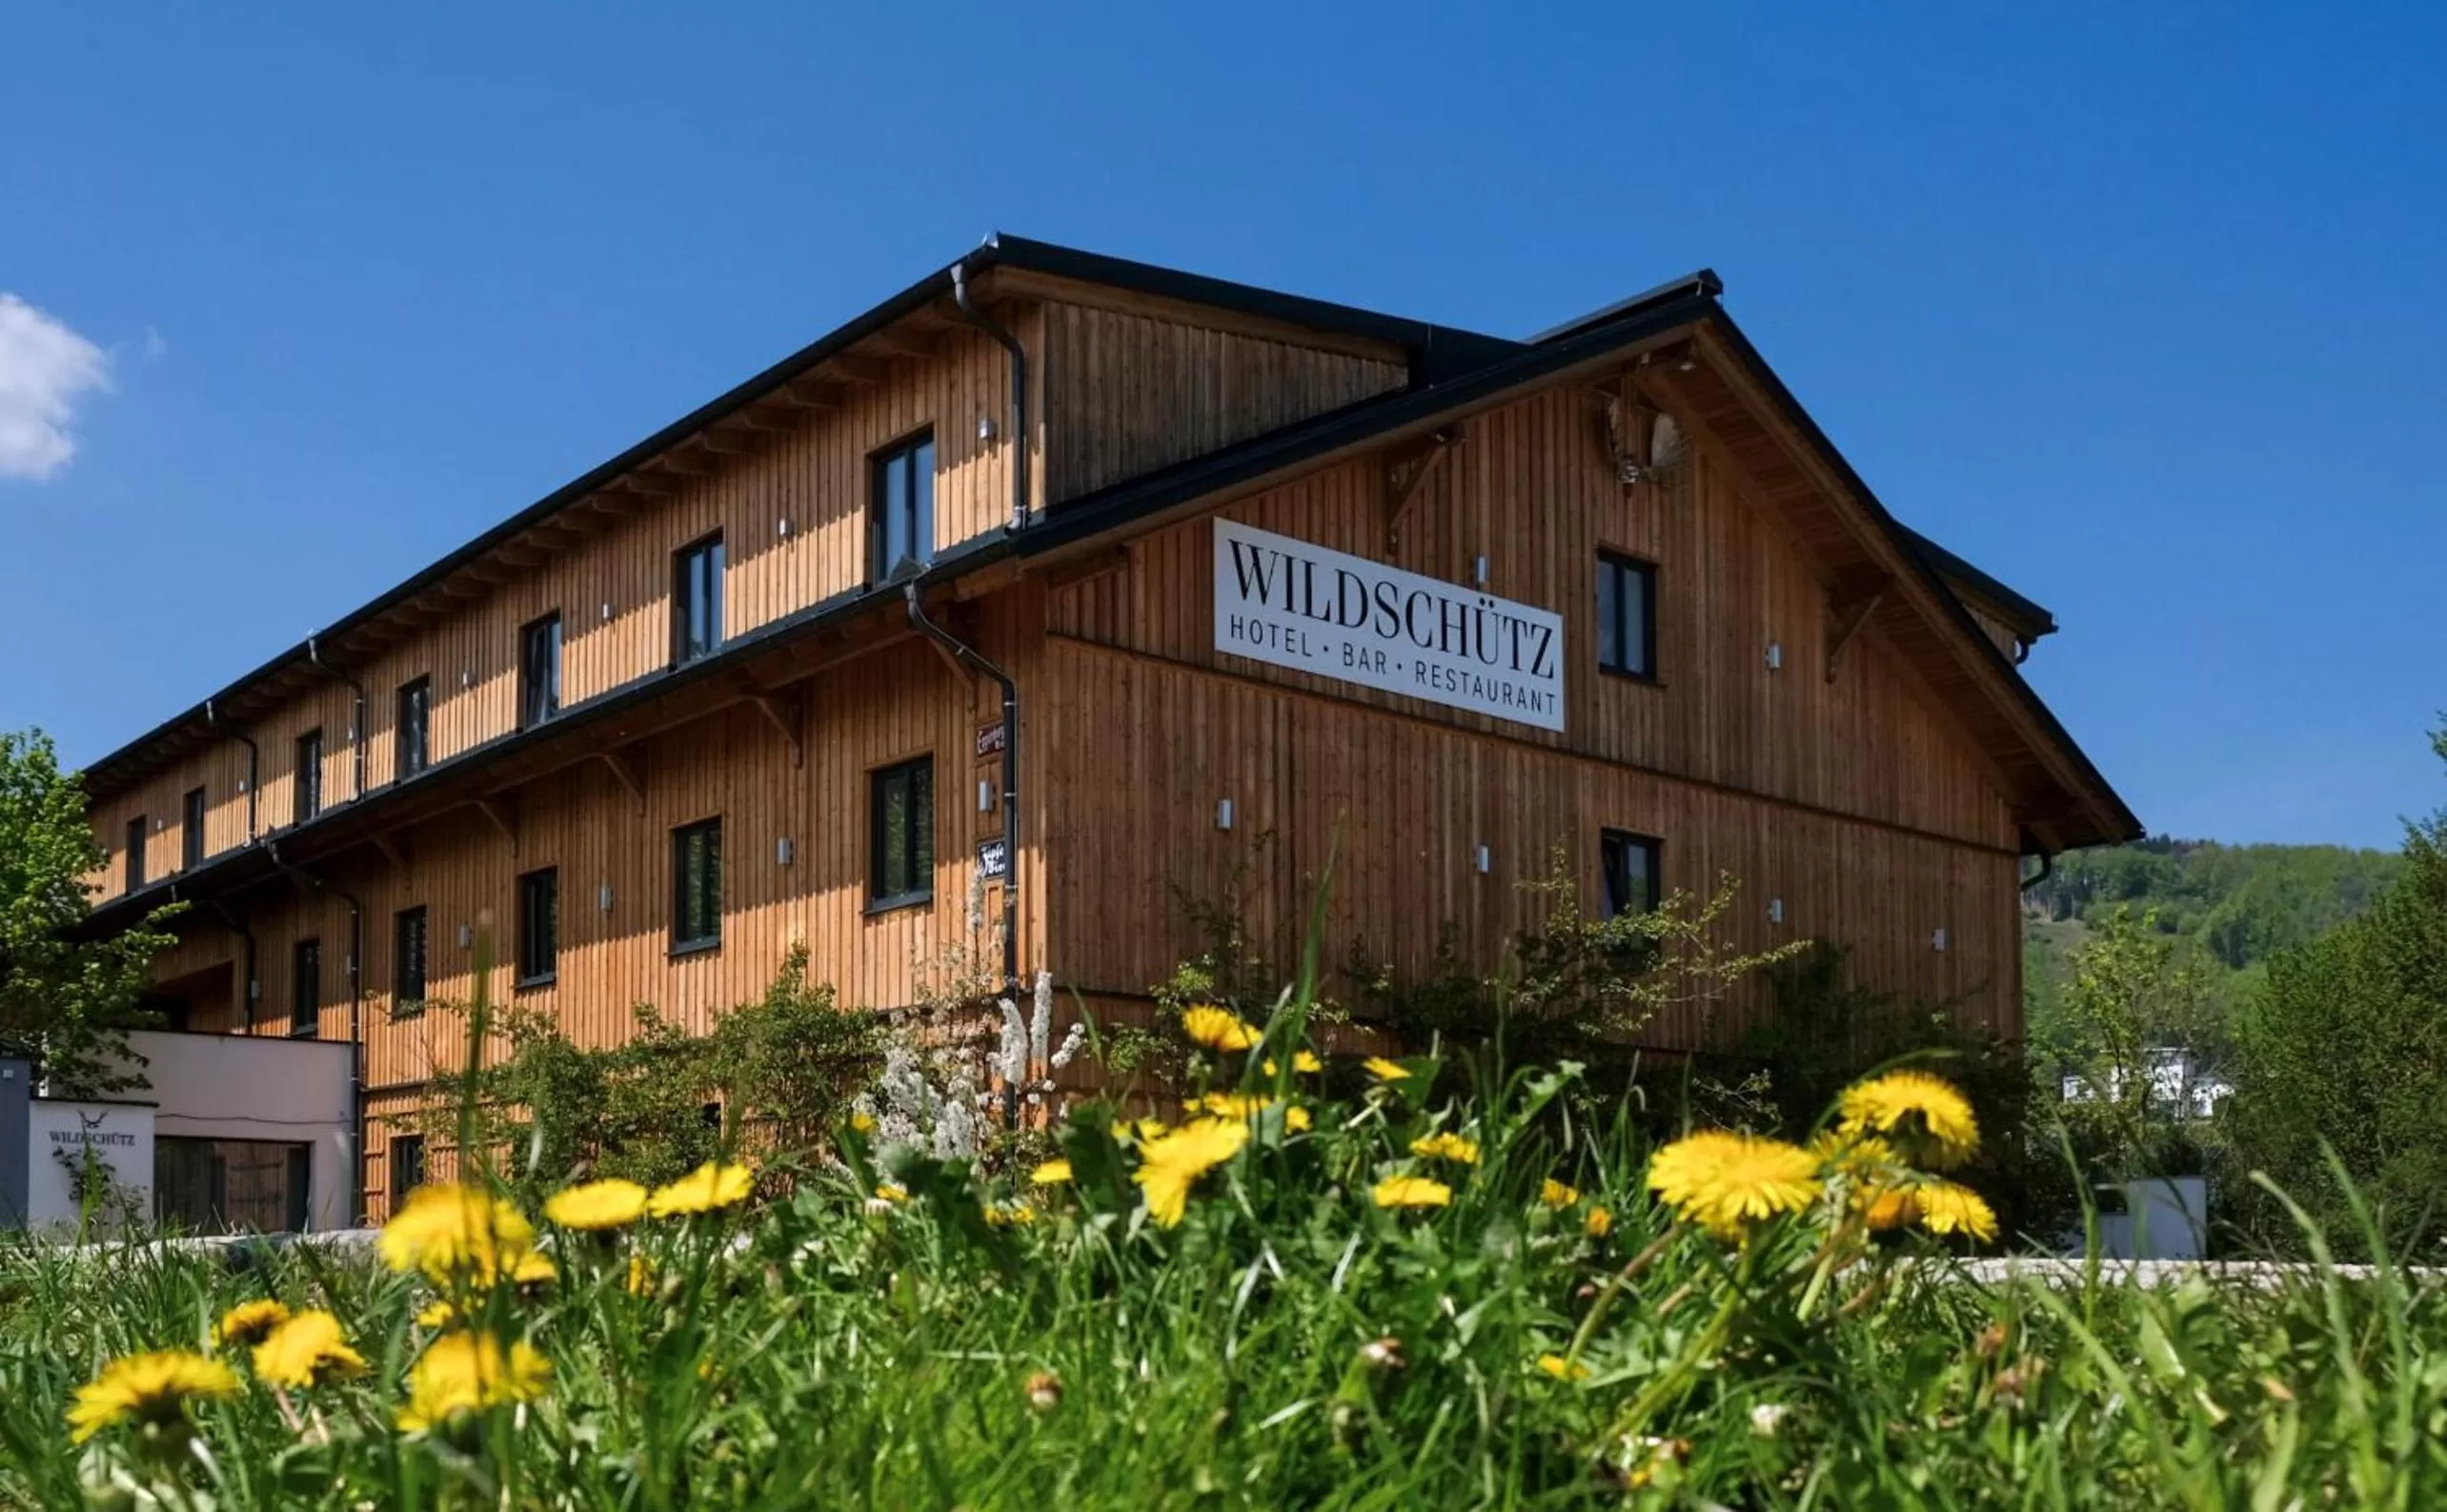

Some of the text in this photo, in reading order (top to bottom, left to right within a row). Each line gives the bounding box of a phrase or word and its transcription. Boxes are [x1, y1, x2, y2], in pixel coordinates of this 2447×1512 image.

[1228, 538, 1555, 679] WILDSCHÜTZ
[1230, 614, 1556, 716] HOTEL BAR RESTAURANT
